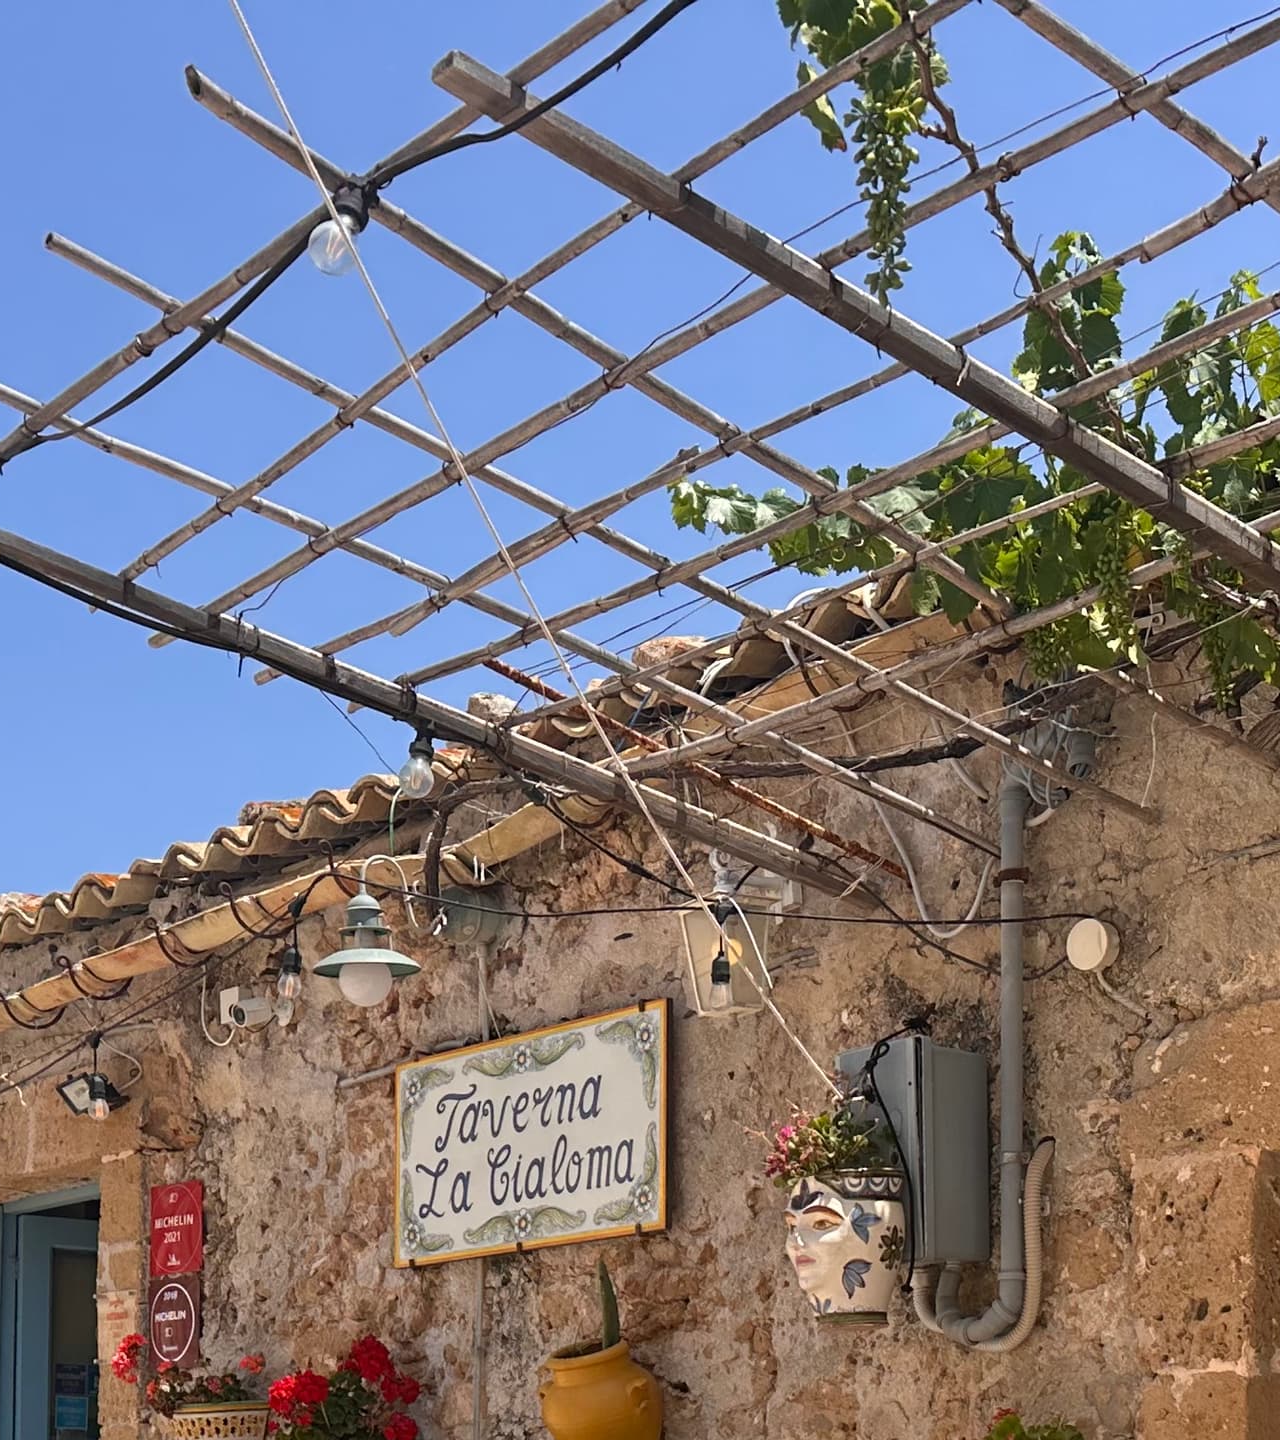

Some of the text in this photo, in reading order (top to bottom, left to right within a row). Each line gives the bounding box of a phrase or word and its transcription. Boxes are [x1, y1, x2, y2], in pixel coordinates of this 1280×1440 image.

[435, 1075, 602, 1152] Taverna
[416, 1134, 634, 1219] La Cialoma
[154, 1213, 194, 1229] MICHELIN
[164, 1231, 181, 1243] 2021
[154, 1310, 186, 1323] MICHELIN
